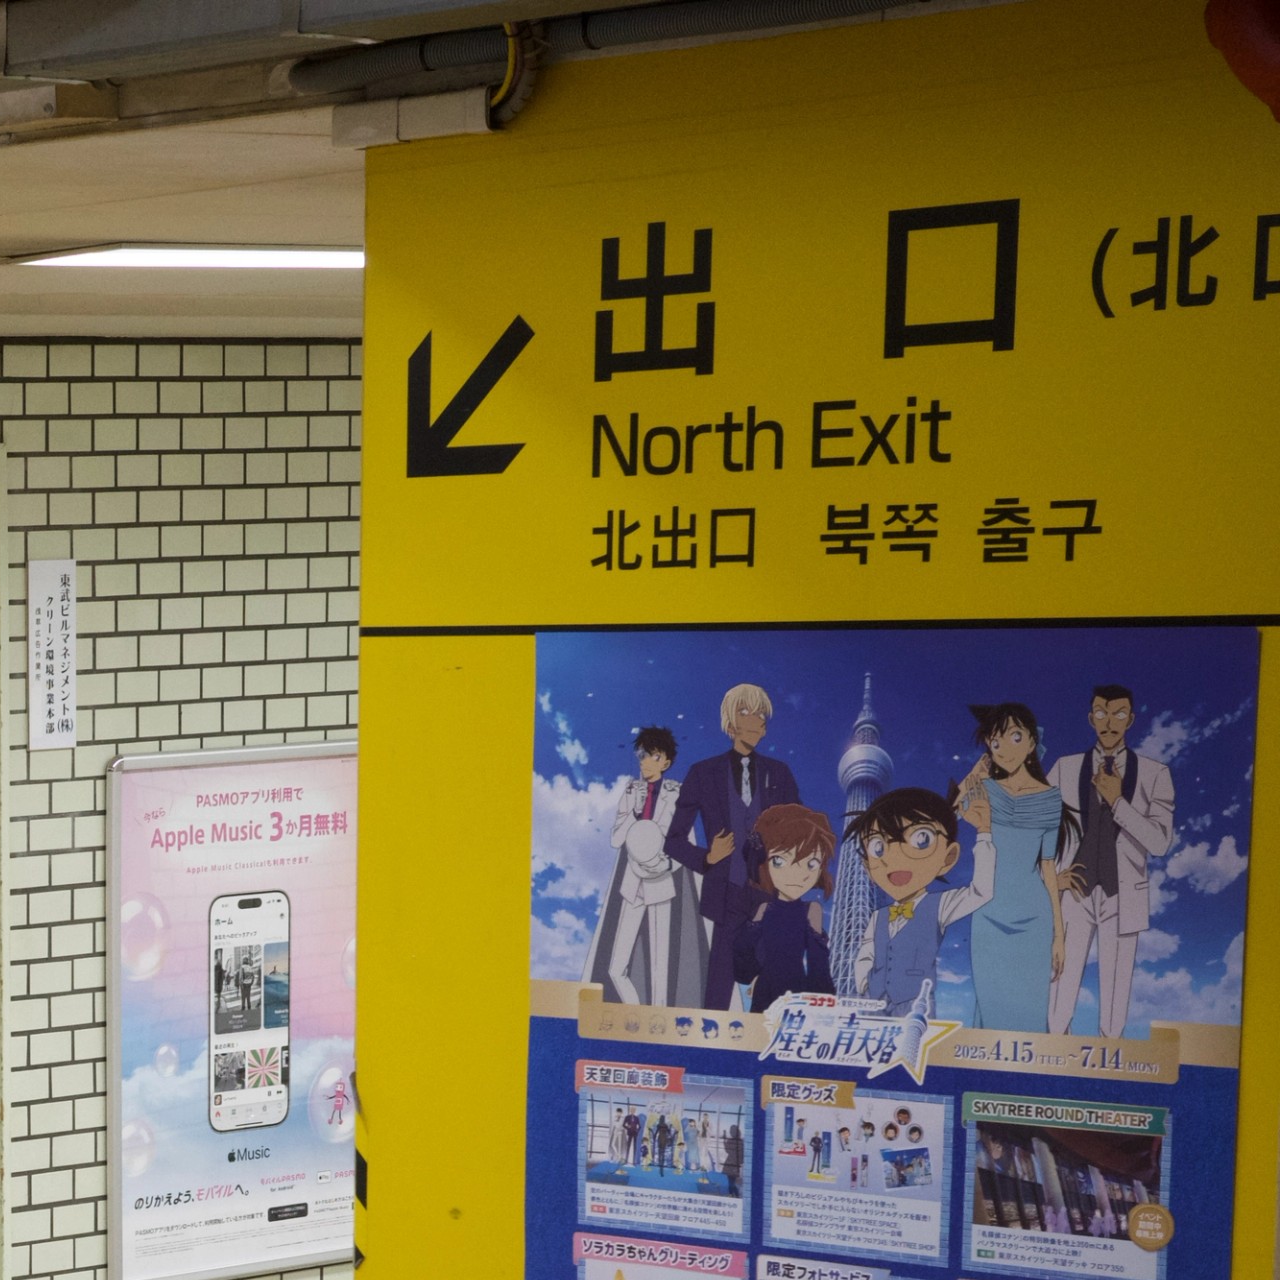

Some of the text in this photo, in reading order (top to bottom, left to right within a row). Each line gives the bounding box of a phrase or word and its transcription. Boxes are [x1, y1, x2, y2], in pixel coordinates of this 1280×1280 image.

[591, 396, 952, 478] North Exit
[590, 498, 1103, 571] 北出口 북쪽 출구
[57, 573, 74, 733] 東武ビルマネジメント(株)
[45, 596, 55, 735] クリーン環境事業本部
[196, 787, 304, 808] PASMOアプリ利用で
[143, 807, 167, 824] 今なら
[151, 811, 348, 852] Apple Music 3か月無料
[187, 865, 208, 874] Apple
[211, 863, 233, 872] Music
[215, 916, 233, 926] ホーム
[584, 1066, 669, 1088] 天望回廊装飾
[770, 1082, 836, 1102] 限定グッズ
[973, 1101, 1033, 1118] SKYTREE
[1035, 1107, 1084, 1122] ROUND
[237, 1145, 271, 1162] Music
[334, 1169, 355, 1180] PASM
[582, 1239, 731, 1271] ソラカラちゃんグリーティング
